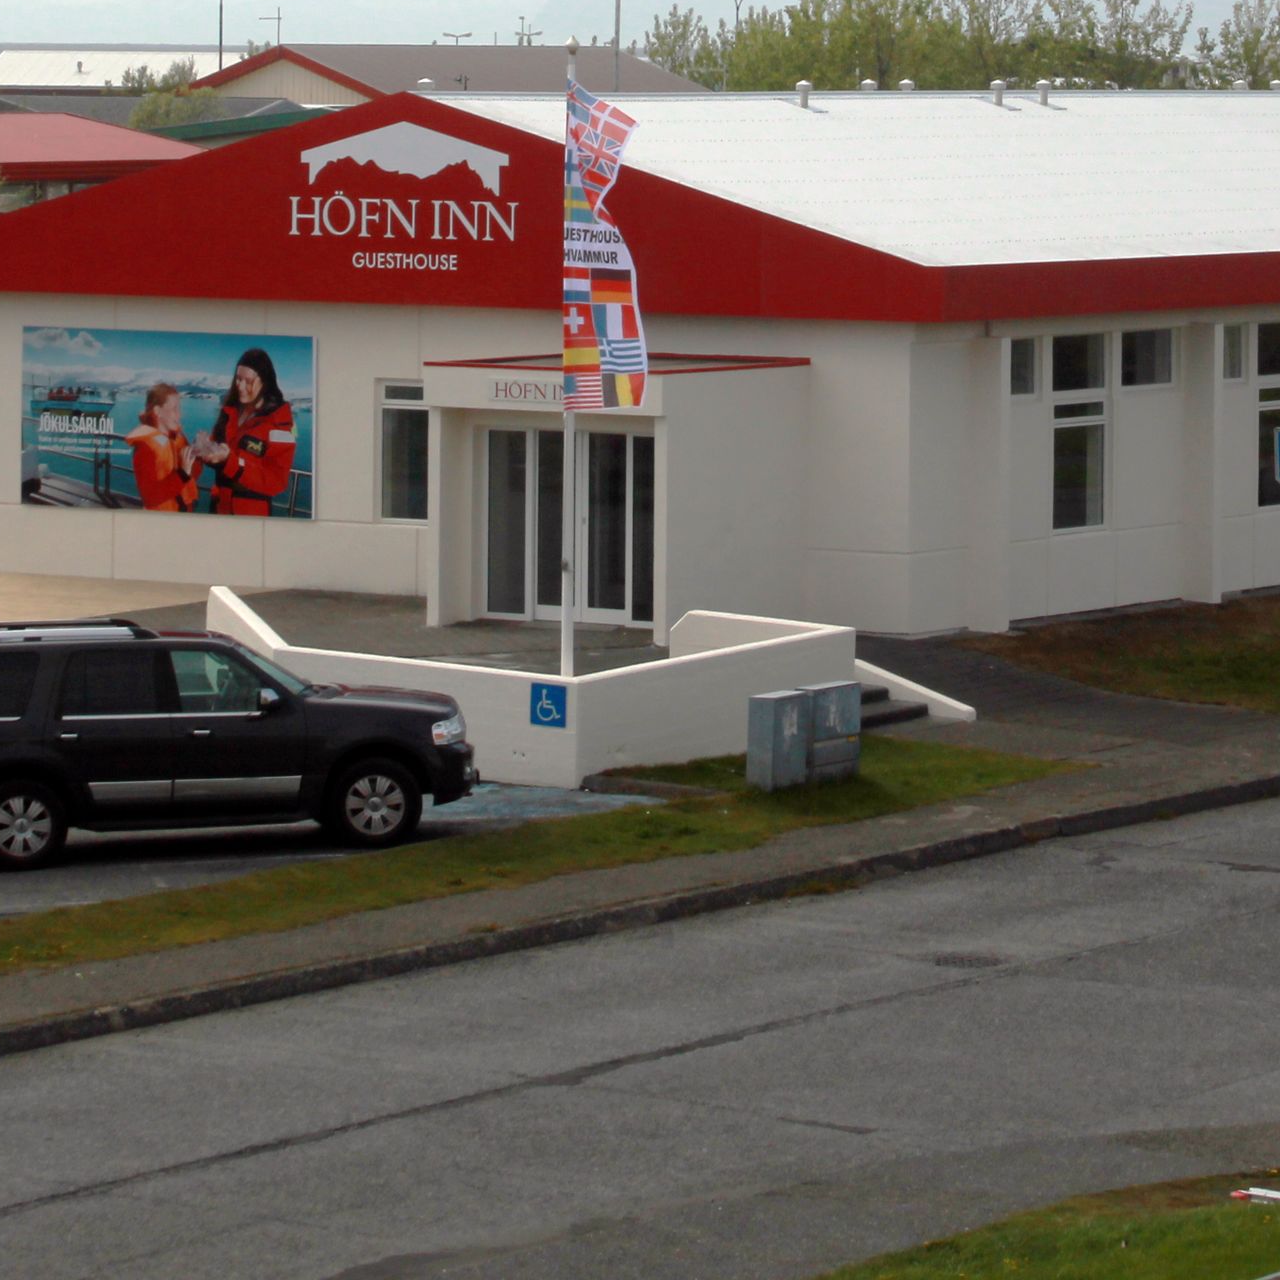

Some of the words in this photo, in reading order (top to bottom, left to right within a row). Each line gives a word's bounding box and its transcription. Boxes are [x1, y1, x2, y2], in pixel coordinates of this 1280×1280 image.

[288, 190, 420, 239] HÖFN
[430, 200, 520, 242] INN
[352, 251, 459, 271] GUESTHOUSE
[564, 248, 619, 265] HVAMMUR
[38, 412, 114, 434] JÖKULSÁRLÓN
